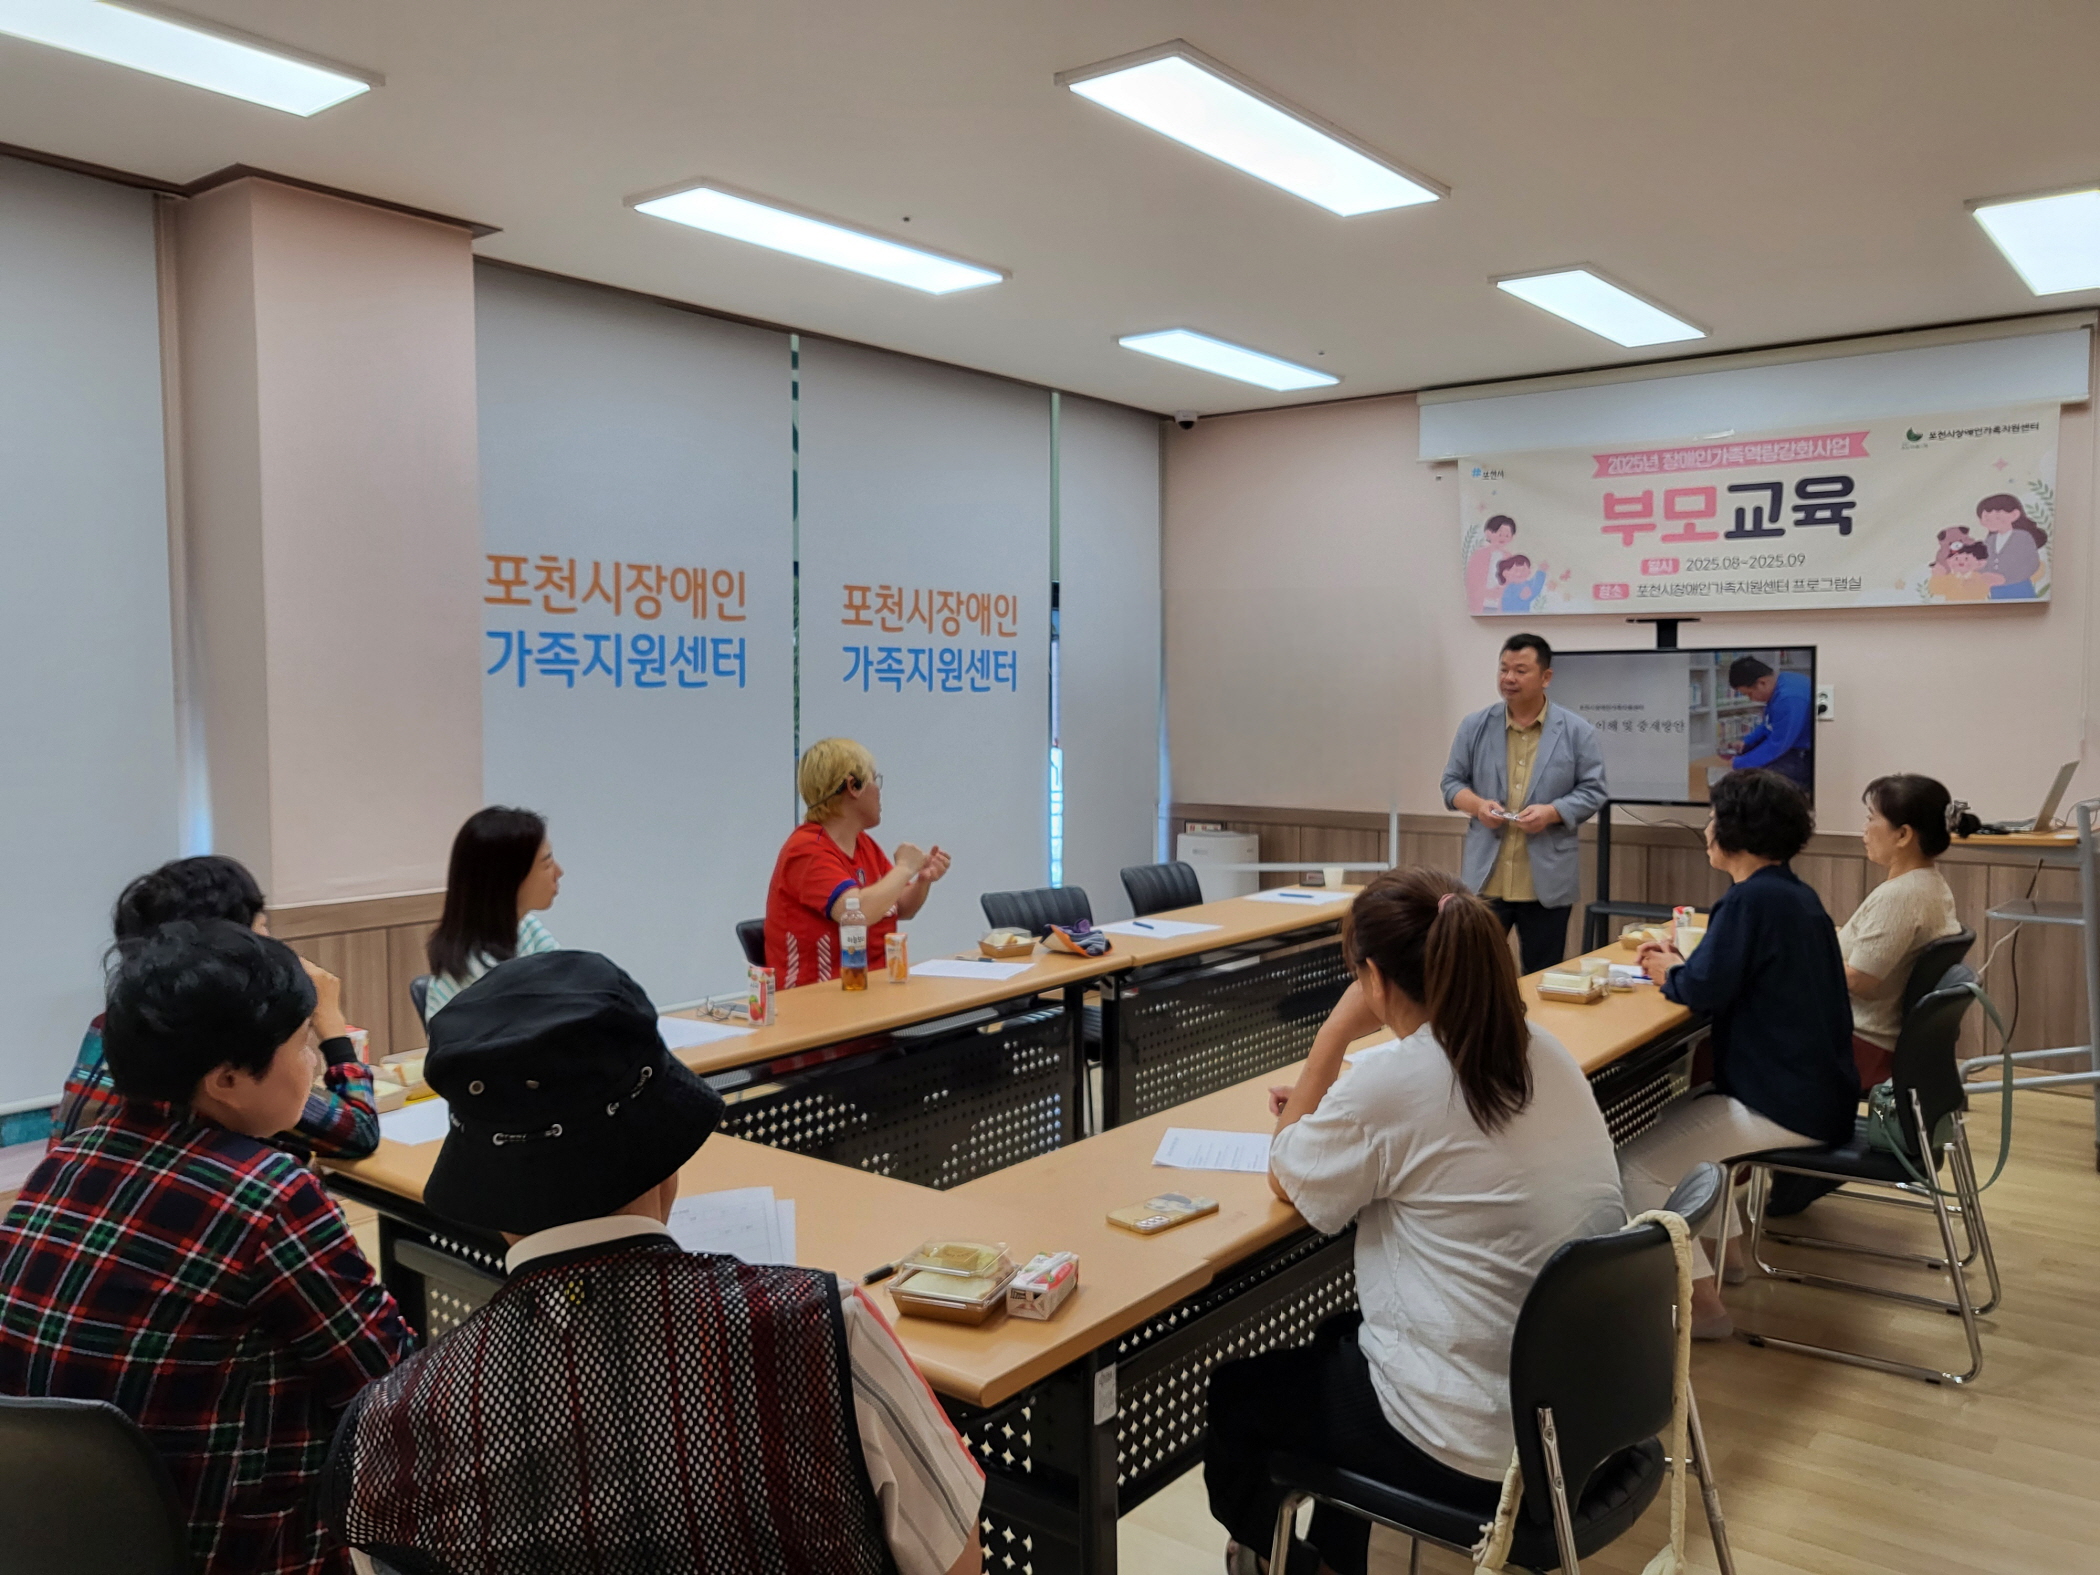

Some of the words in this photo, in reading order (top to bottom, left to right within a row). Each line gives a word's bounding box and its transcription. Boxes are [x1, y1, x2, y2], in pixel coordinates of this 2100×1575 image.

[1607, 454, 1660, 475] 2025년
[484, 554, 746, 622] 포천시장애인
[841, 583, 1018, 638] 포천시장애인
[1636, 580, 1789, 598] 포천시장애인가족지원센터
[1791, 575, 1862, 593] 프로그램실
[486, 629, 746, 689] 가족지원센터
[841, 645, 1018, 693] 가족지원센터
